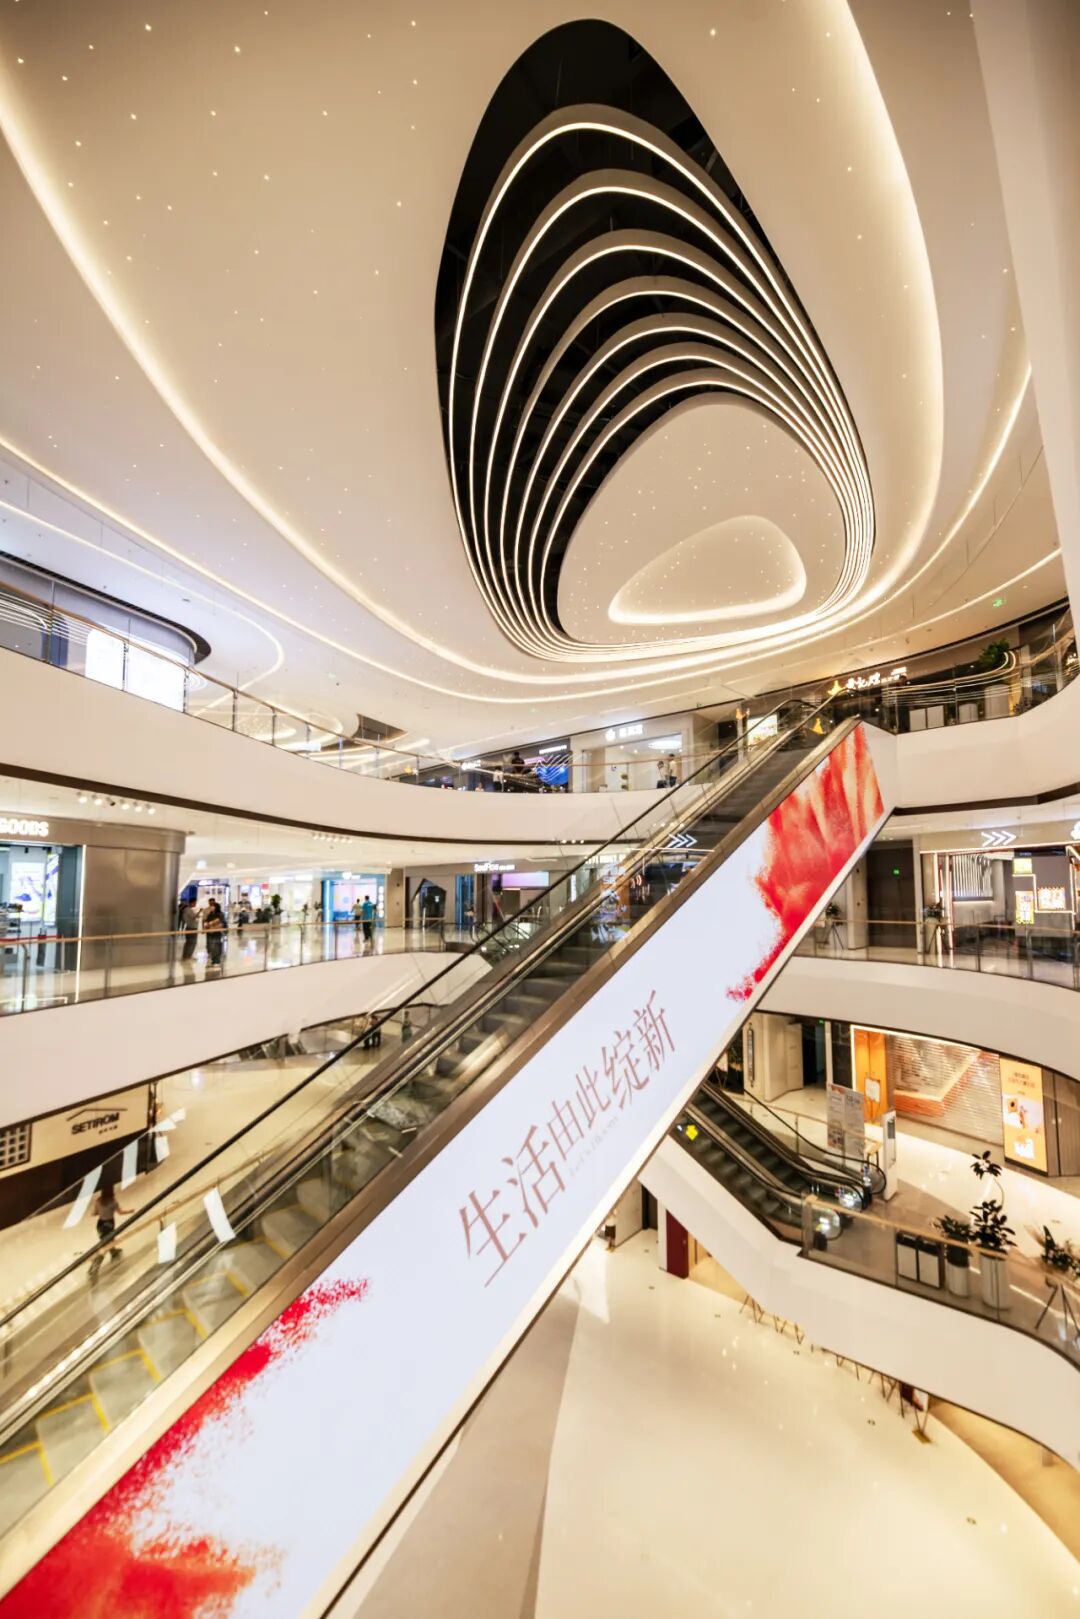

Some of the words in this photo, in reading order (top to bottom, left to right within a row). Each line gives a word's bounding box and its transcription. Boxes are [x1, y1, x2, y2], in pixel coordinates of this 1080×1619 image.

[459, 990, 675, 1287] 生活由此绽新
